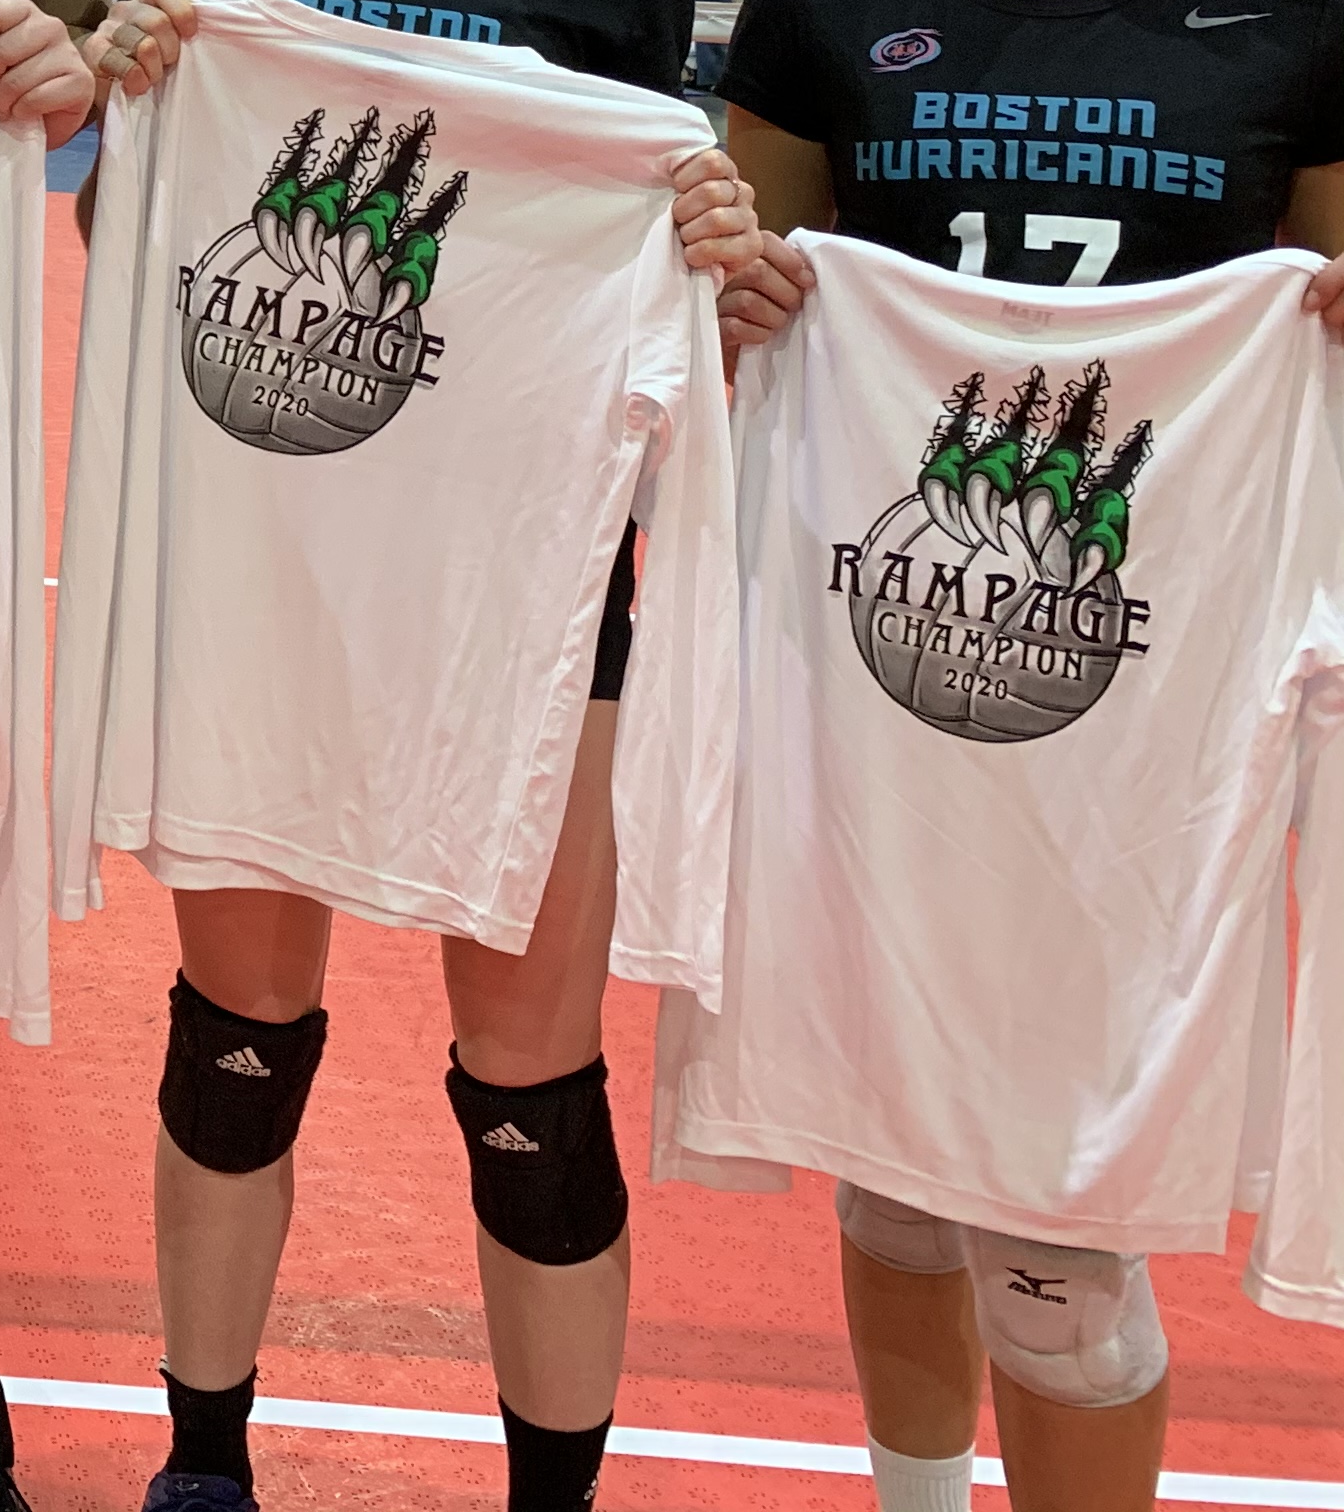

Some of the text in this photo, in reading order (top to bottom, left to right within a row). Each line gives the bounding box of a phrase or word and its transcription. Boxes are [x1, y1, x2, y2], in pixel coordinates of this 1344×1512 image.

[913, 92, 1155, 138] BOSTON
[855, 138, 1226, 201] HURRICANES
[949, 211, 1121, 287] 17
[175, 265, 445, 386] RAMPAGE
[199, 332, 382, 406] CHAMPION
[252, 385, 309, 417] 2020
[827, 543, 1151, 654] RAMPAGE
[877, 611, 1086, 681] CHAMPION
[944, 669, 1008, 700] 2020
[215, 1058, 271, 1077] adidas
[482, 1135, 540, 1152] adidas
